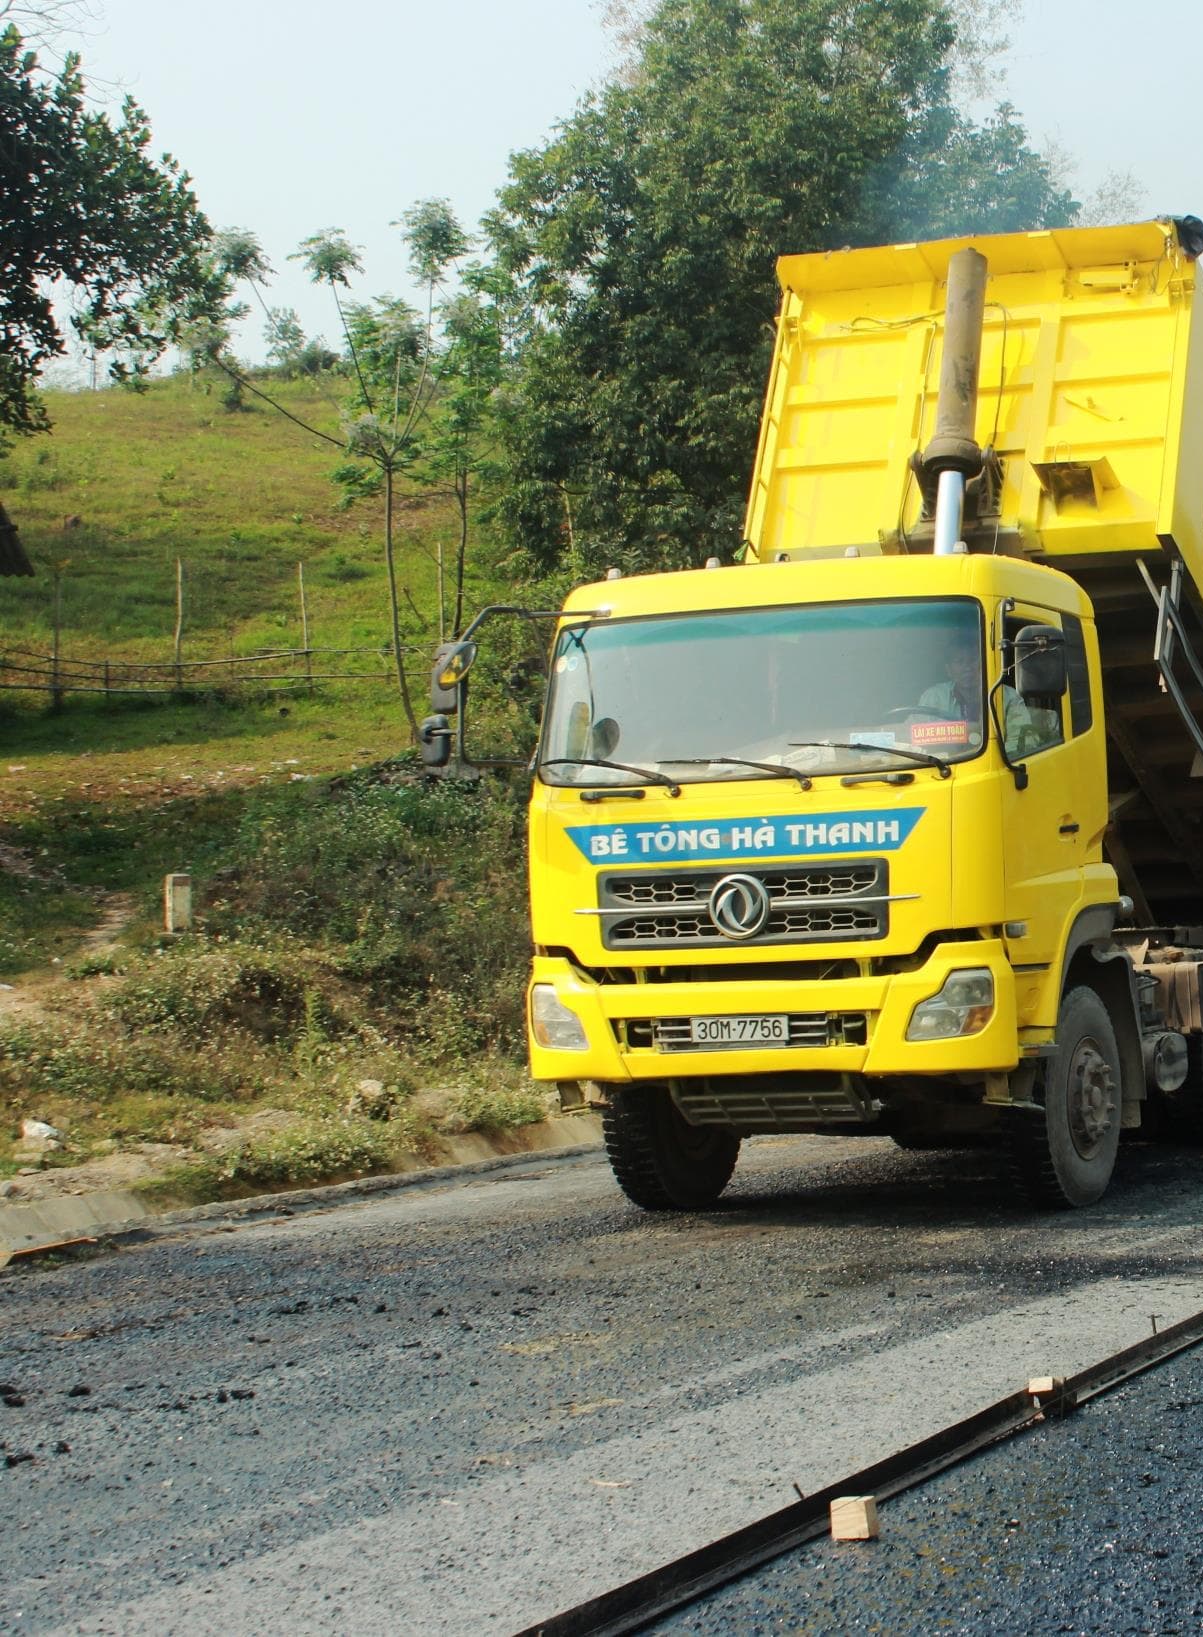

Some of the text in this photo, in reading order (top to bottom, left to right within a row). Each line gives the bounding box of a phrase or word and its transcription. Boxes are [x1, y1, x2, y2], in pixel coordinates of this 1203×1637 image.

[591, 818, 899, 856] BÊ TÔNG HÀ THANH
